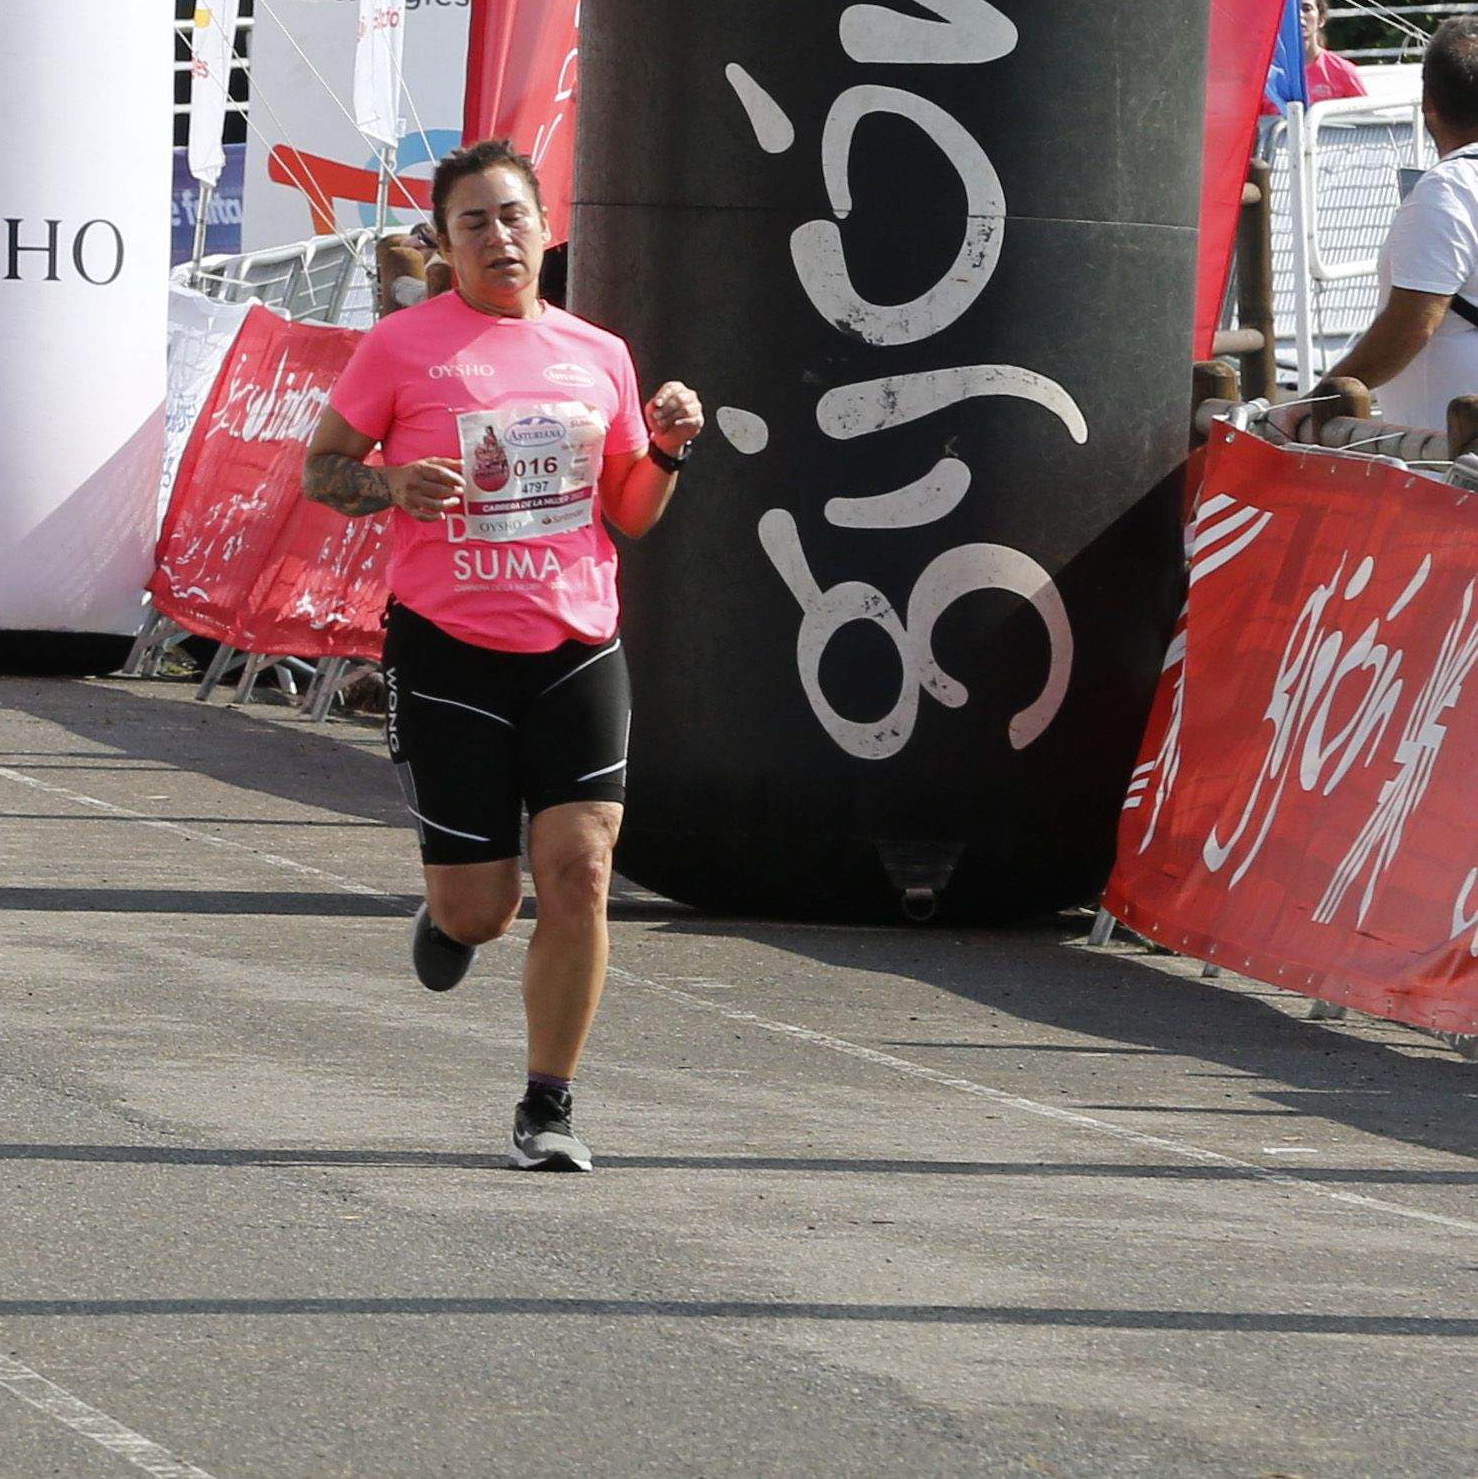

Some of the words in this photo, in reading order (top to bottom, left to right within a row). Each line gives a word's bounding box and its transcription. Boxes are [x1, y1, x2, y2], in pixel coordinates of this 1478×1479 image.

[429, 364, 495, 379] OYSHO
[510, 429, 561, 440] ASTURIANA
[514, 456, 558, 477] 016
[522, 481, 549, 494] 4797
[454, 548, 563, 581] SUMA
[386, 667, 400, 753] WONG
